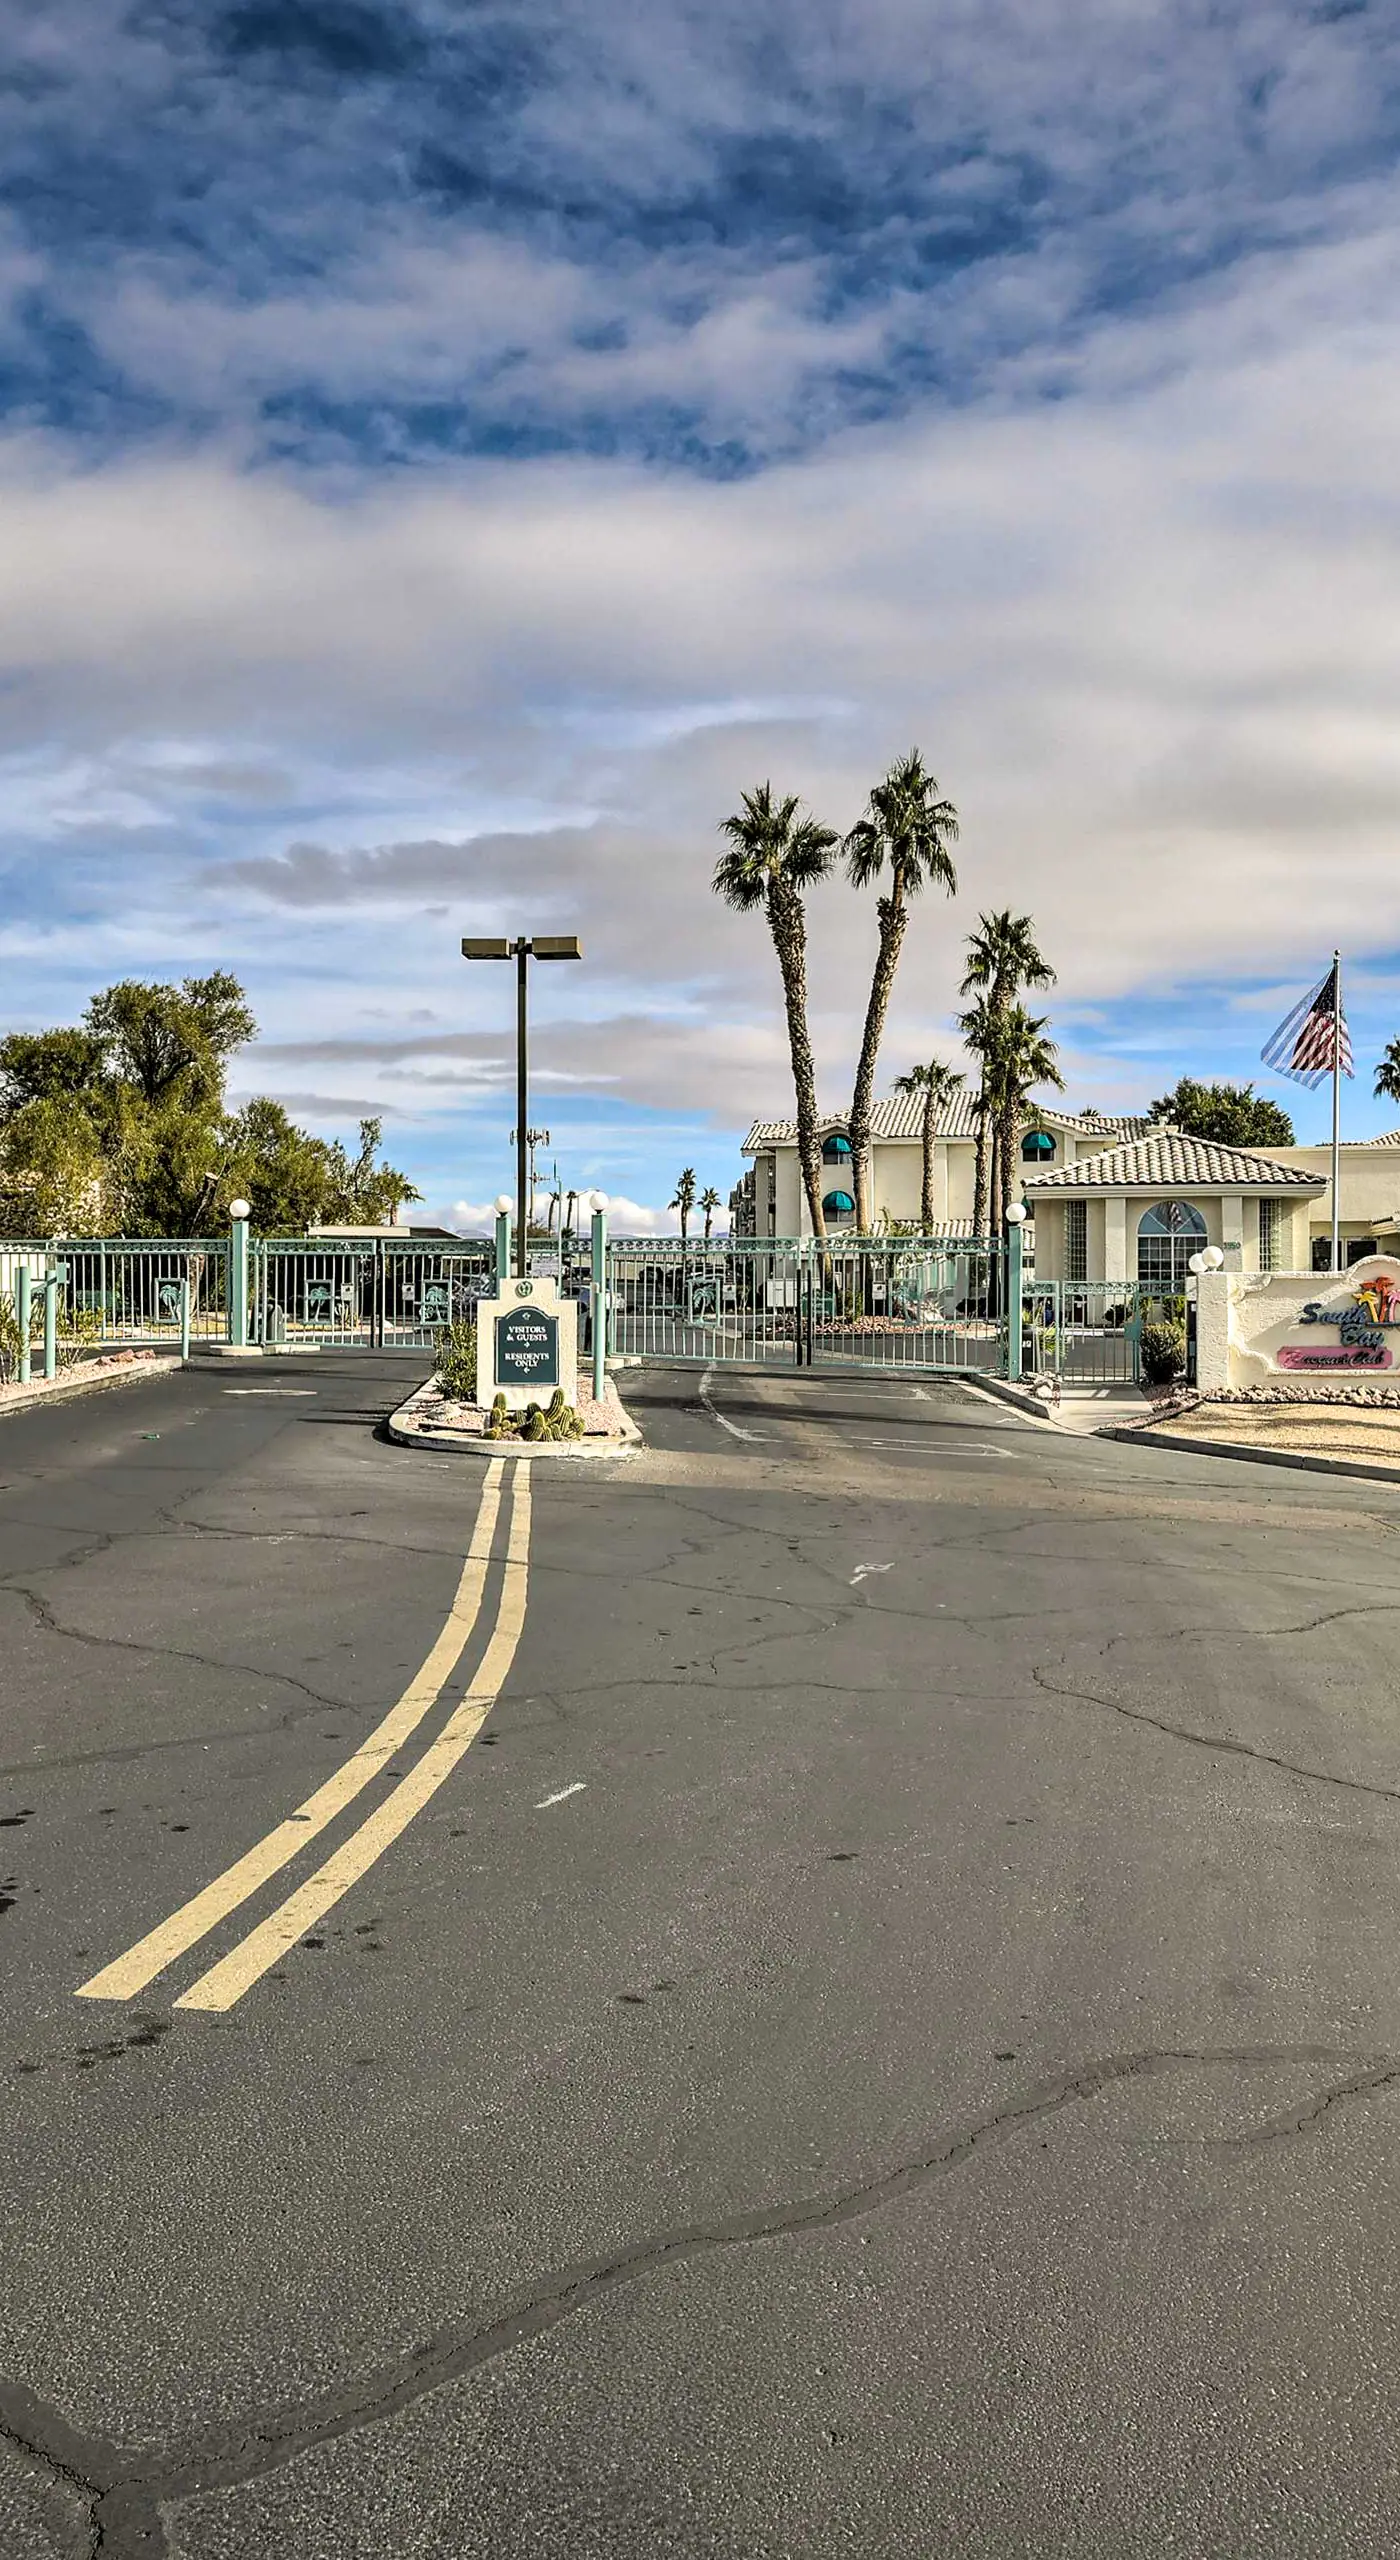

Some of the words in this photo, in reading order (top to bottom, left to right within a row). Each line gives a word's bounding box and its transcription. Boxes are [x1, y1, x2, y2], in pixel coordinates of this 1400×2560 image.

[1300, 1303, 1367, 1324] South
[508, 1325, 546, 1333] VISITORS
[506, 1333, 514, 1341] &
[516, 1333, 548, 1341] GUESTS
[1340, 1324, 1384, 1350] Bay
[504, 1352, 549, 1360] RESIDENTS
[1349, 1350, 1384, 1366] Club
[514, 1359, 539, 1367] ONLY
